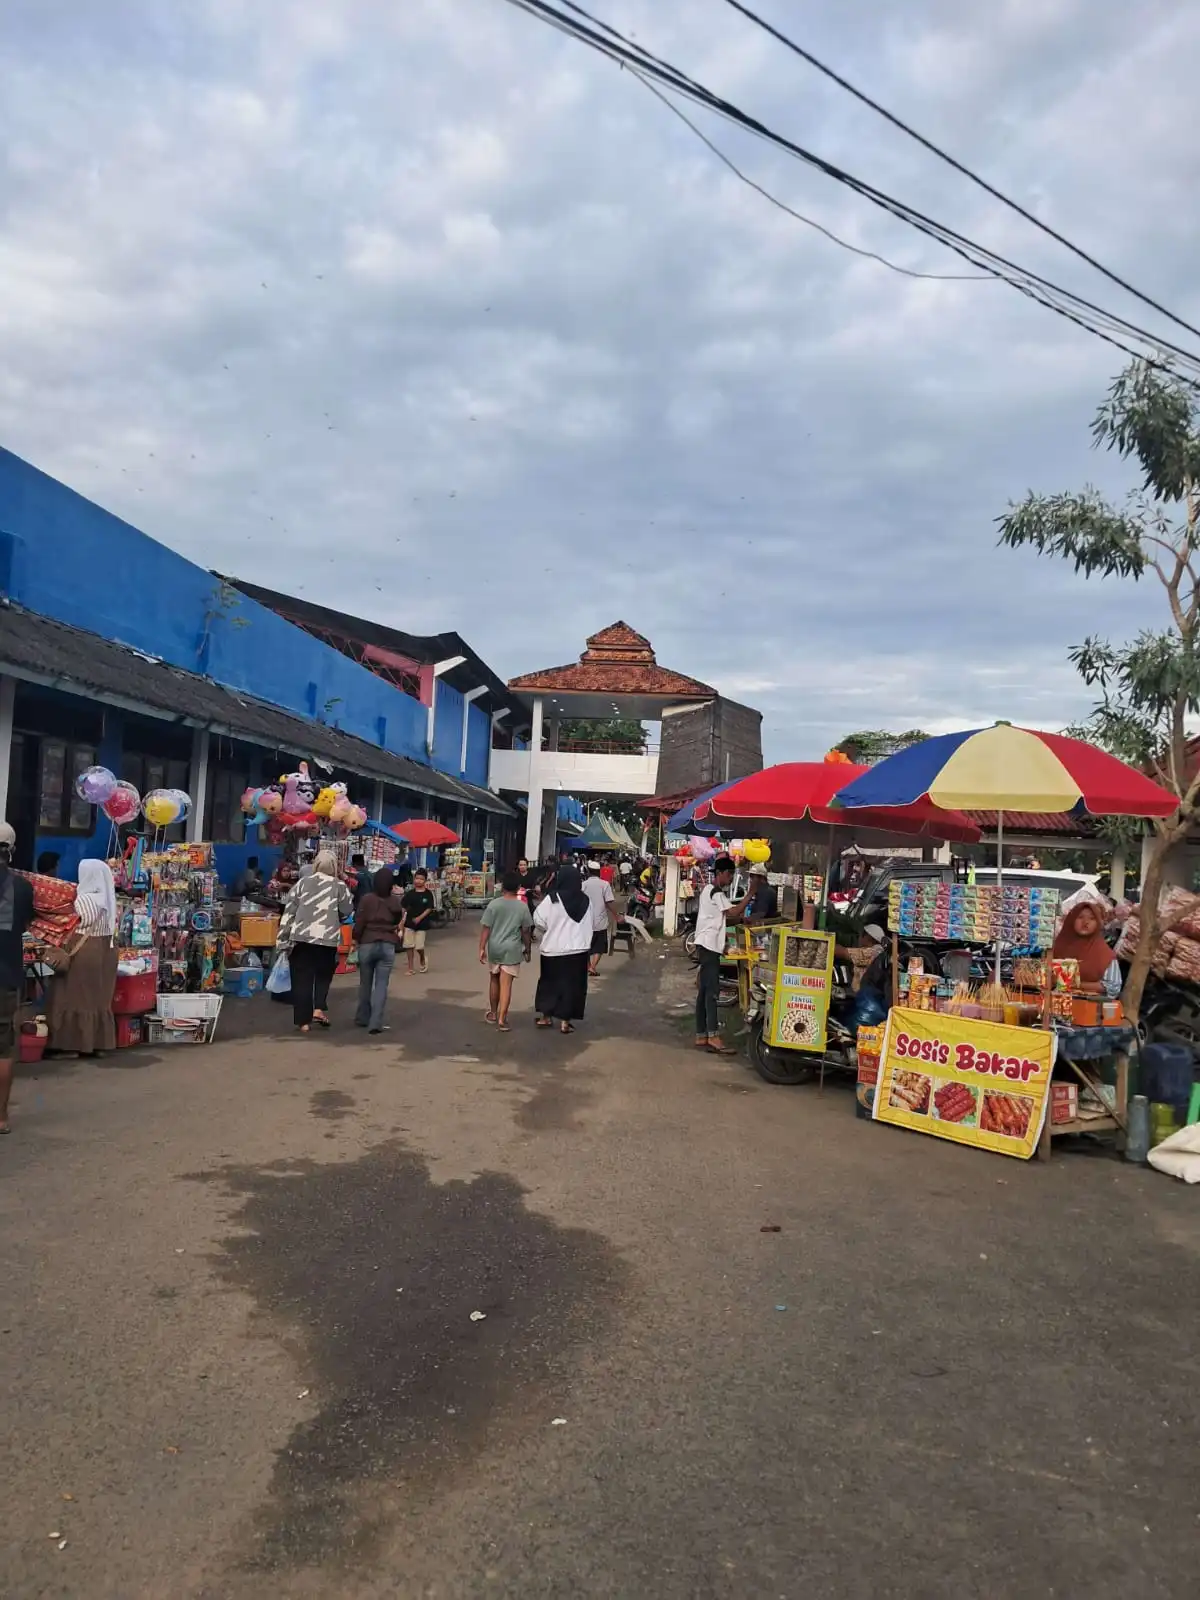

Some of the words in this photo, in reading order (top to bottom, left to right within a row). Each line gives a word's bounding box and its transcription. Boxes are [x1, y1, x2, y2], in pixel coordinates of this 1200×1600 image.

[801, 976, 826, 988] KEMBANG
[786, 1001, 816, 1011] KEMBANG
[896, 1033, 950, 1064] Sosis
[955, 1043, 1040, 1081] Bakar
